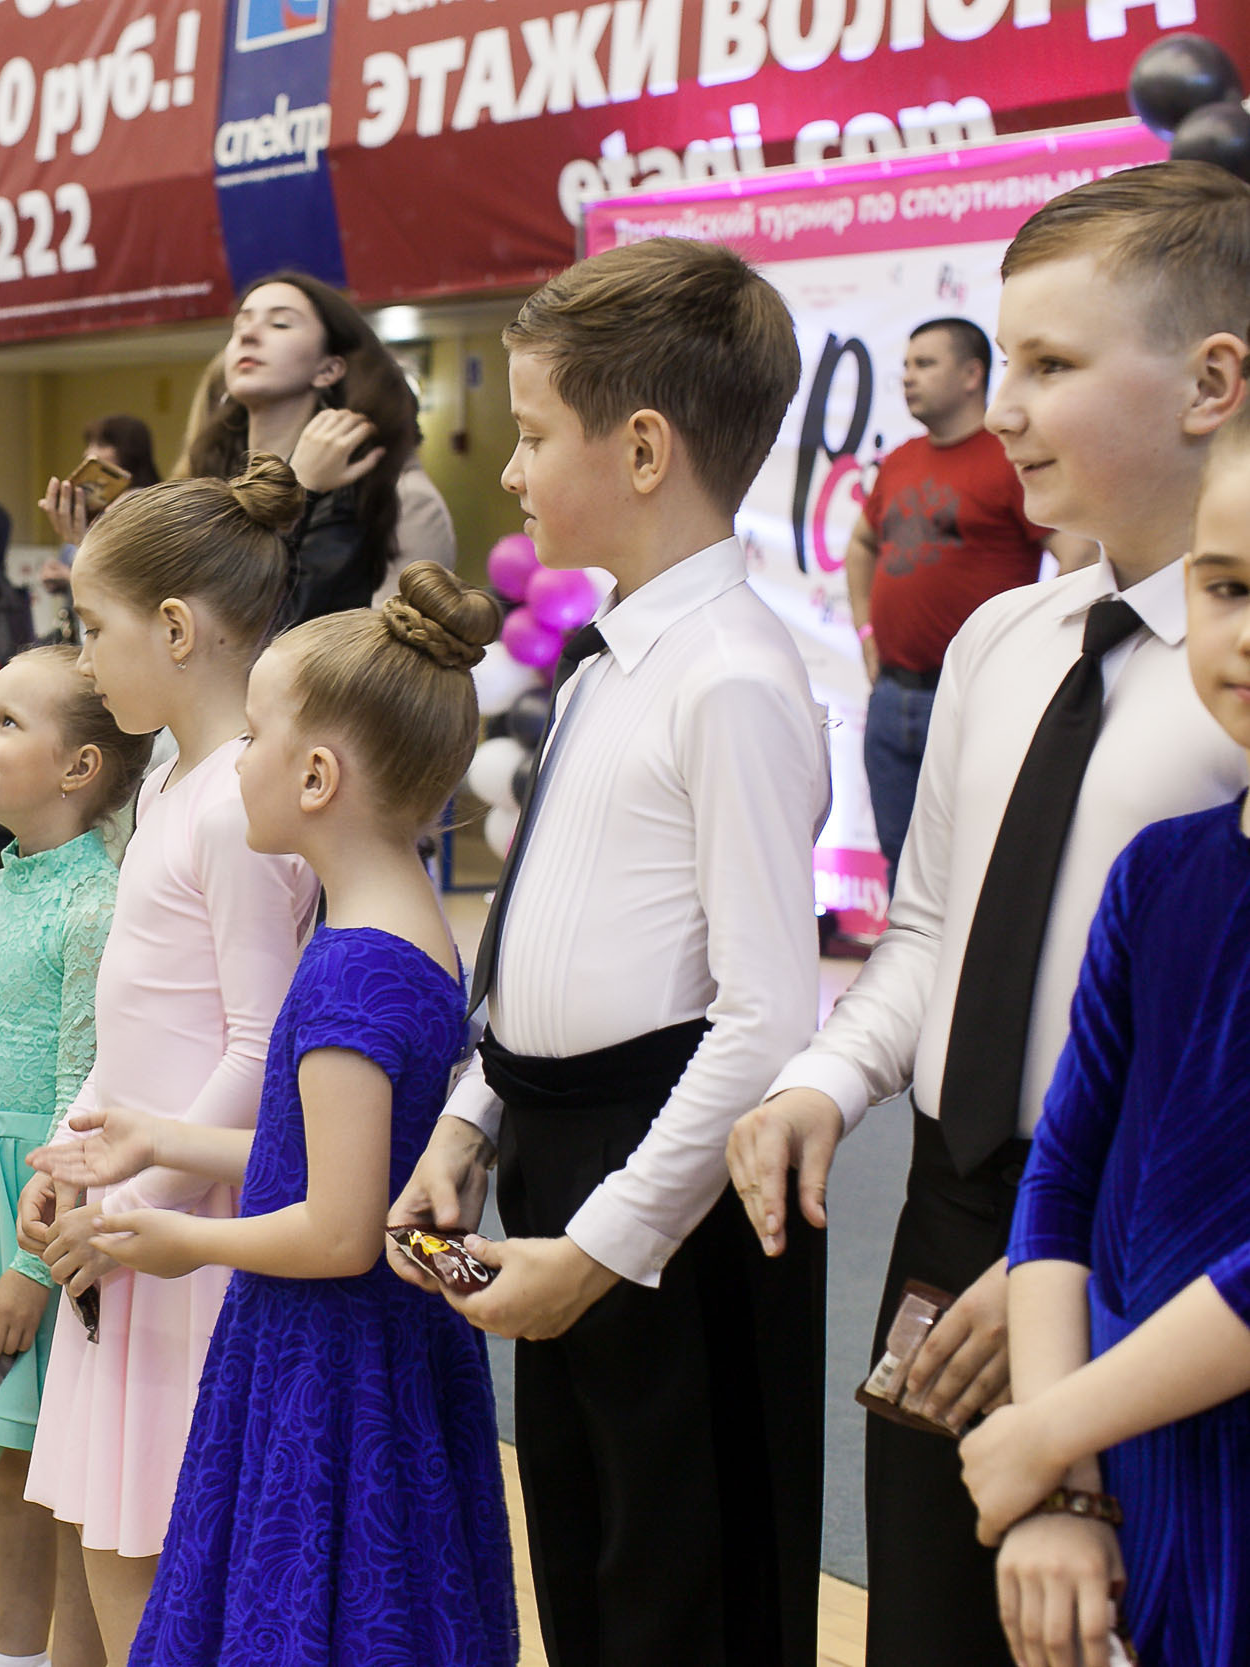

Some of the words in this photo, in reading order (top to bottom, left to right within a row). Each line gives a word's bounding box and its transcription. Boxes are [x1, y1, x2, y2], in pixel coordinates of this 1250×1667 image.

[35, 10, 201, 163] руб.!
[356, 0, 682, 149] ЭТАЖИ
[697, 0, 1198, 88] ВОЛ
[558, 95, 996, 228] etaicom
[760, 193, 854, 242] турнир
[858, 191, 895, 224] по
